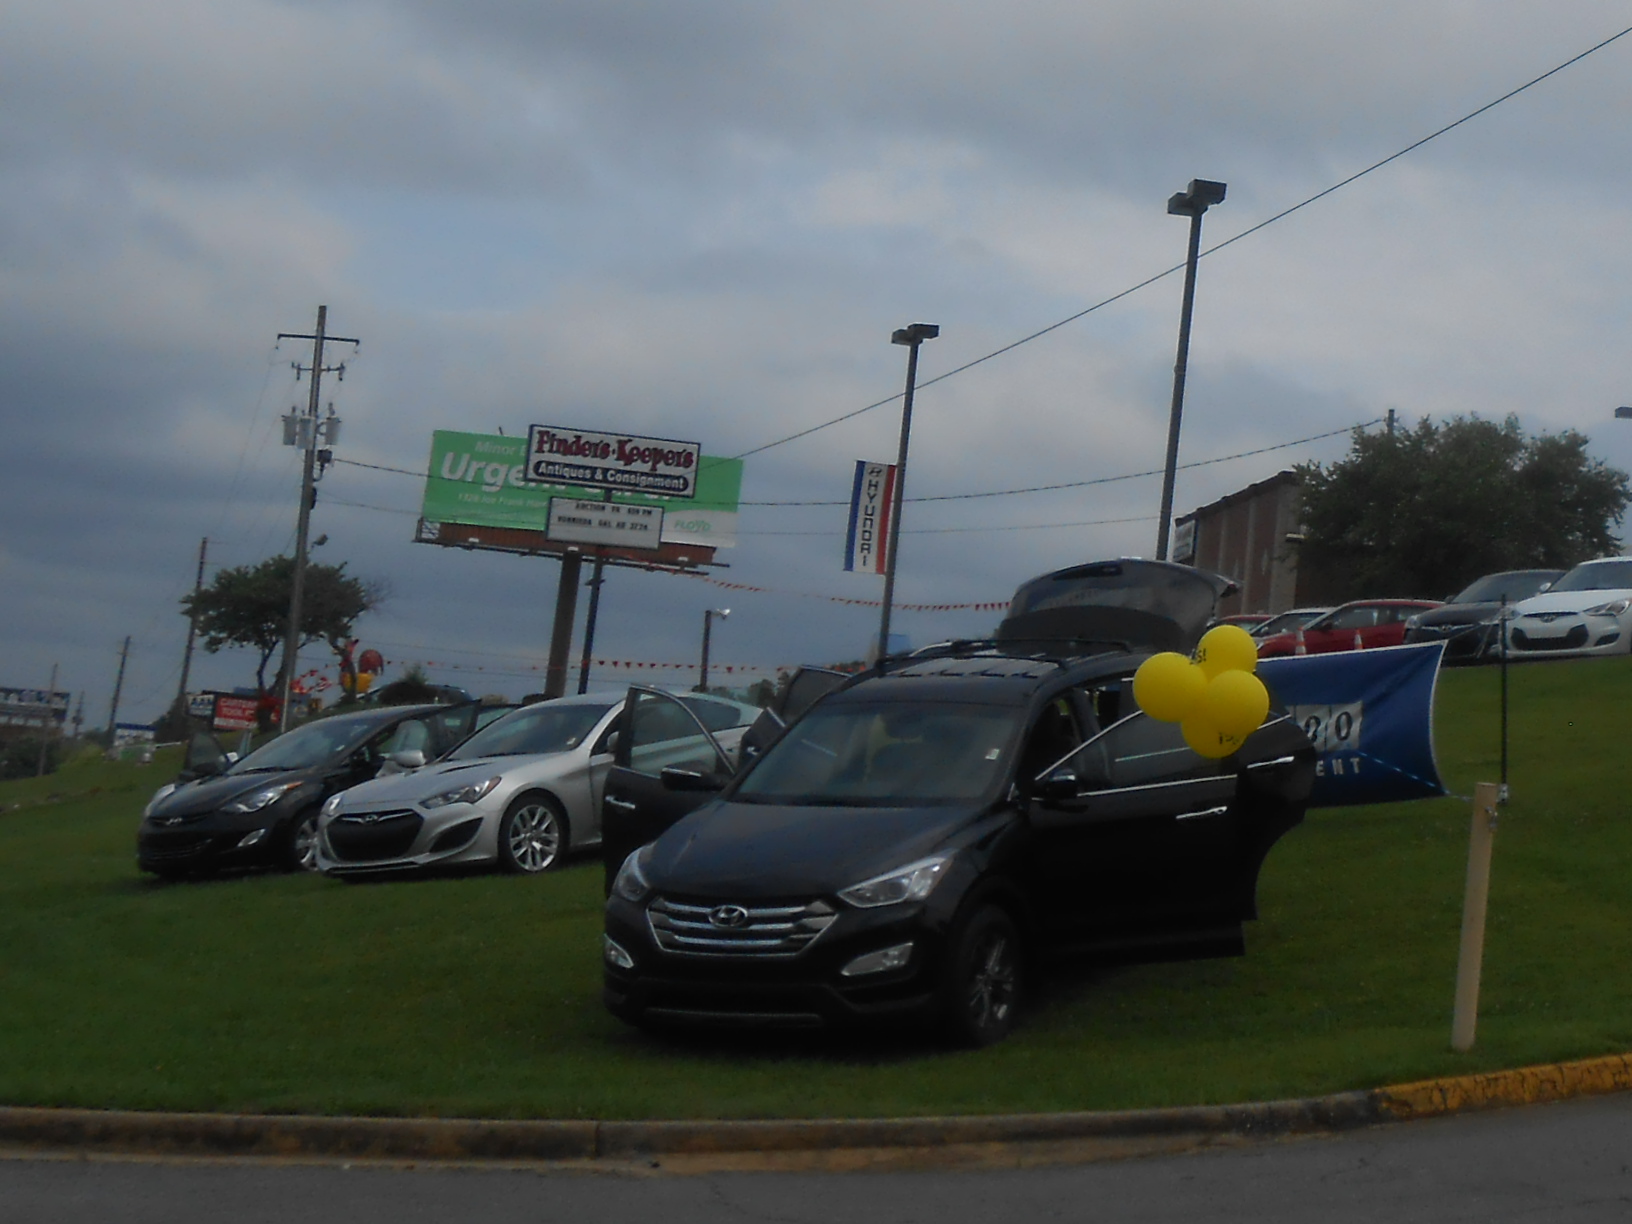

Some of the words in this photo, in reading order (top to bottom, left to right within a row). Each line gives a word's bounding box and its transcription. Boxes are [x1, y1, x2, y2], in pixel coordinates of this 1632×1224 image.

[535, 430, 611, 460] Finders
[614, 439, 694, 472] Keepers
[441, 452, 566, 493] Urge
[538, 462, 592, 478] Antiques
[594, 468, 603, 480] &
[607, 470, 685, 489] Consignment
[860, 479, 879, 566] HYUNDAI
